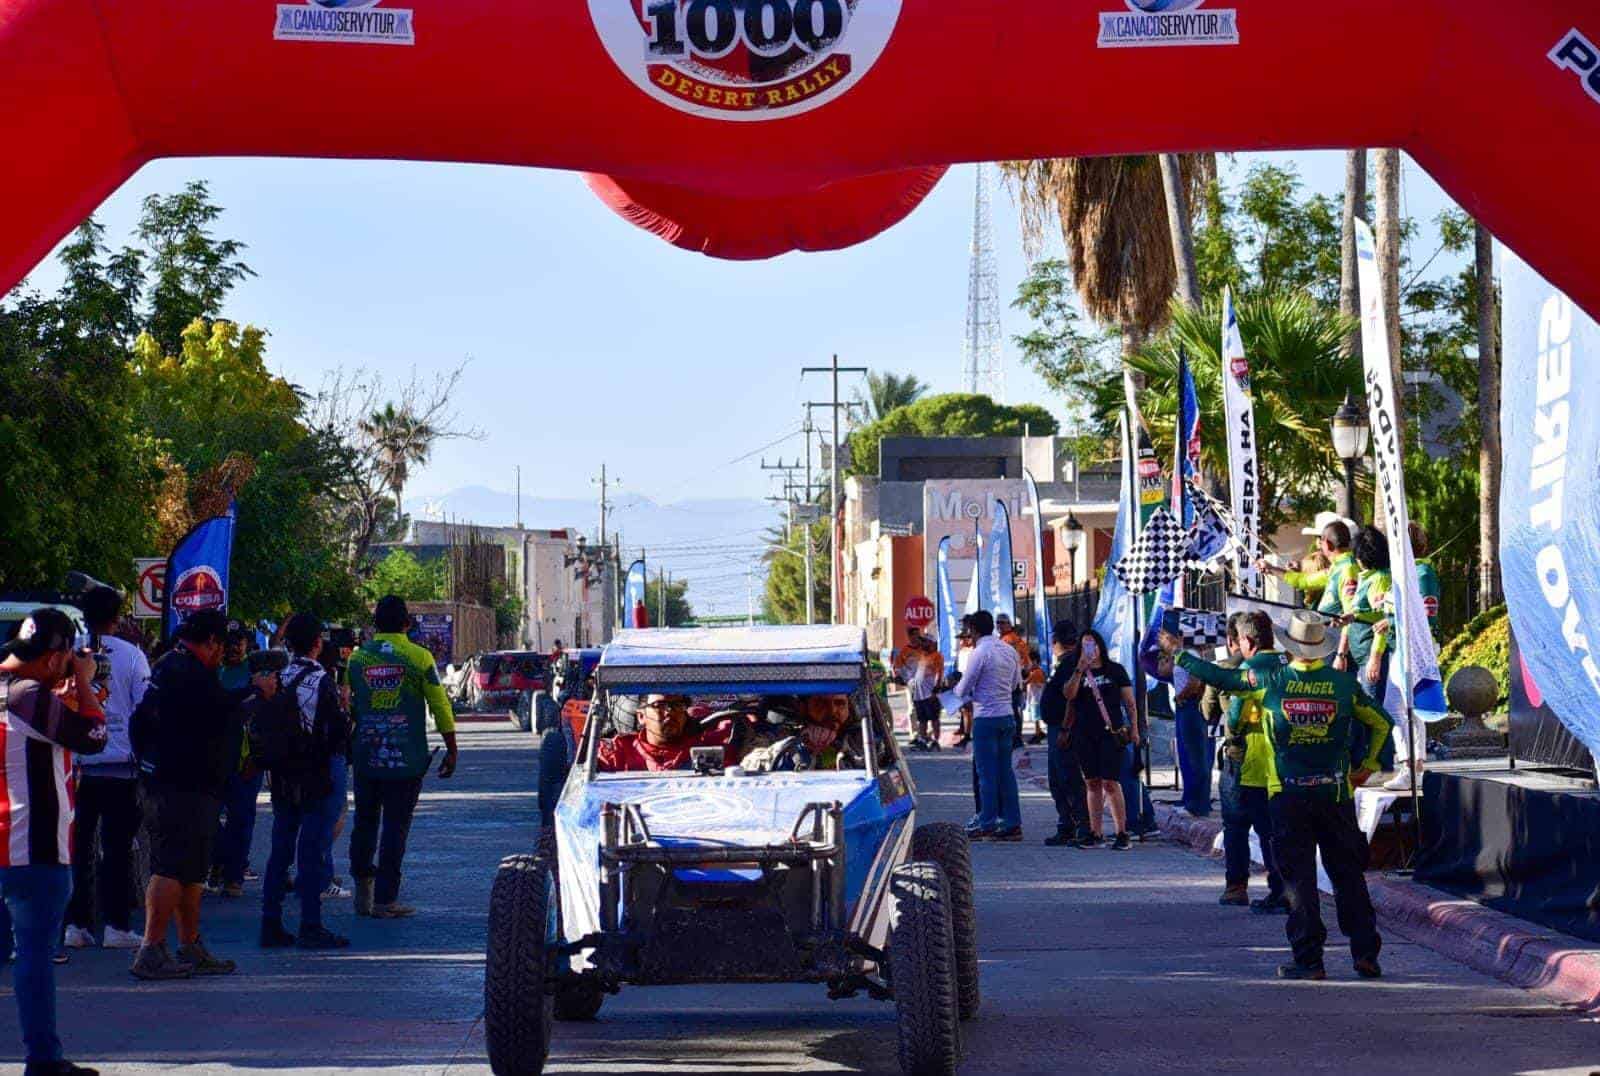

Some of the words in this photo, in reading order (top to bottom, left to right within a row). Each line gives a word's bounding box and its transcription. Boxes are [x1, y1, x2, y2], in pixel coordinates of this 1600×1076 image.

[293, 9, 395, 34] CANACOSERVYTUR
[648, 0, 843, 55] 1000
[1116, 14, 1218, 37] CANACOSERVYTUR
[658, 68, 756, 106] DESERT
[766, 57, 844, 105] RALLY
[905, 606, 933, 619] ALTO
[1285, 680, 1335, 695] RANGEL
